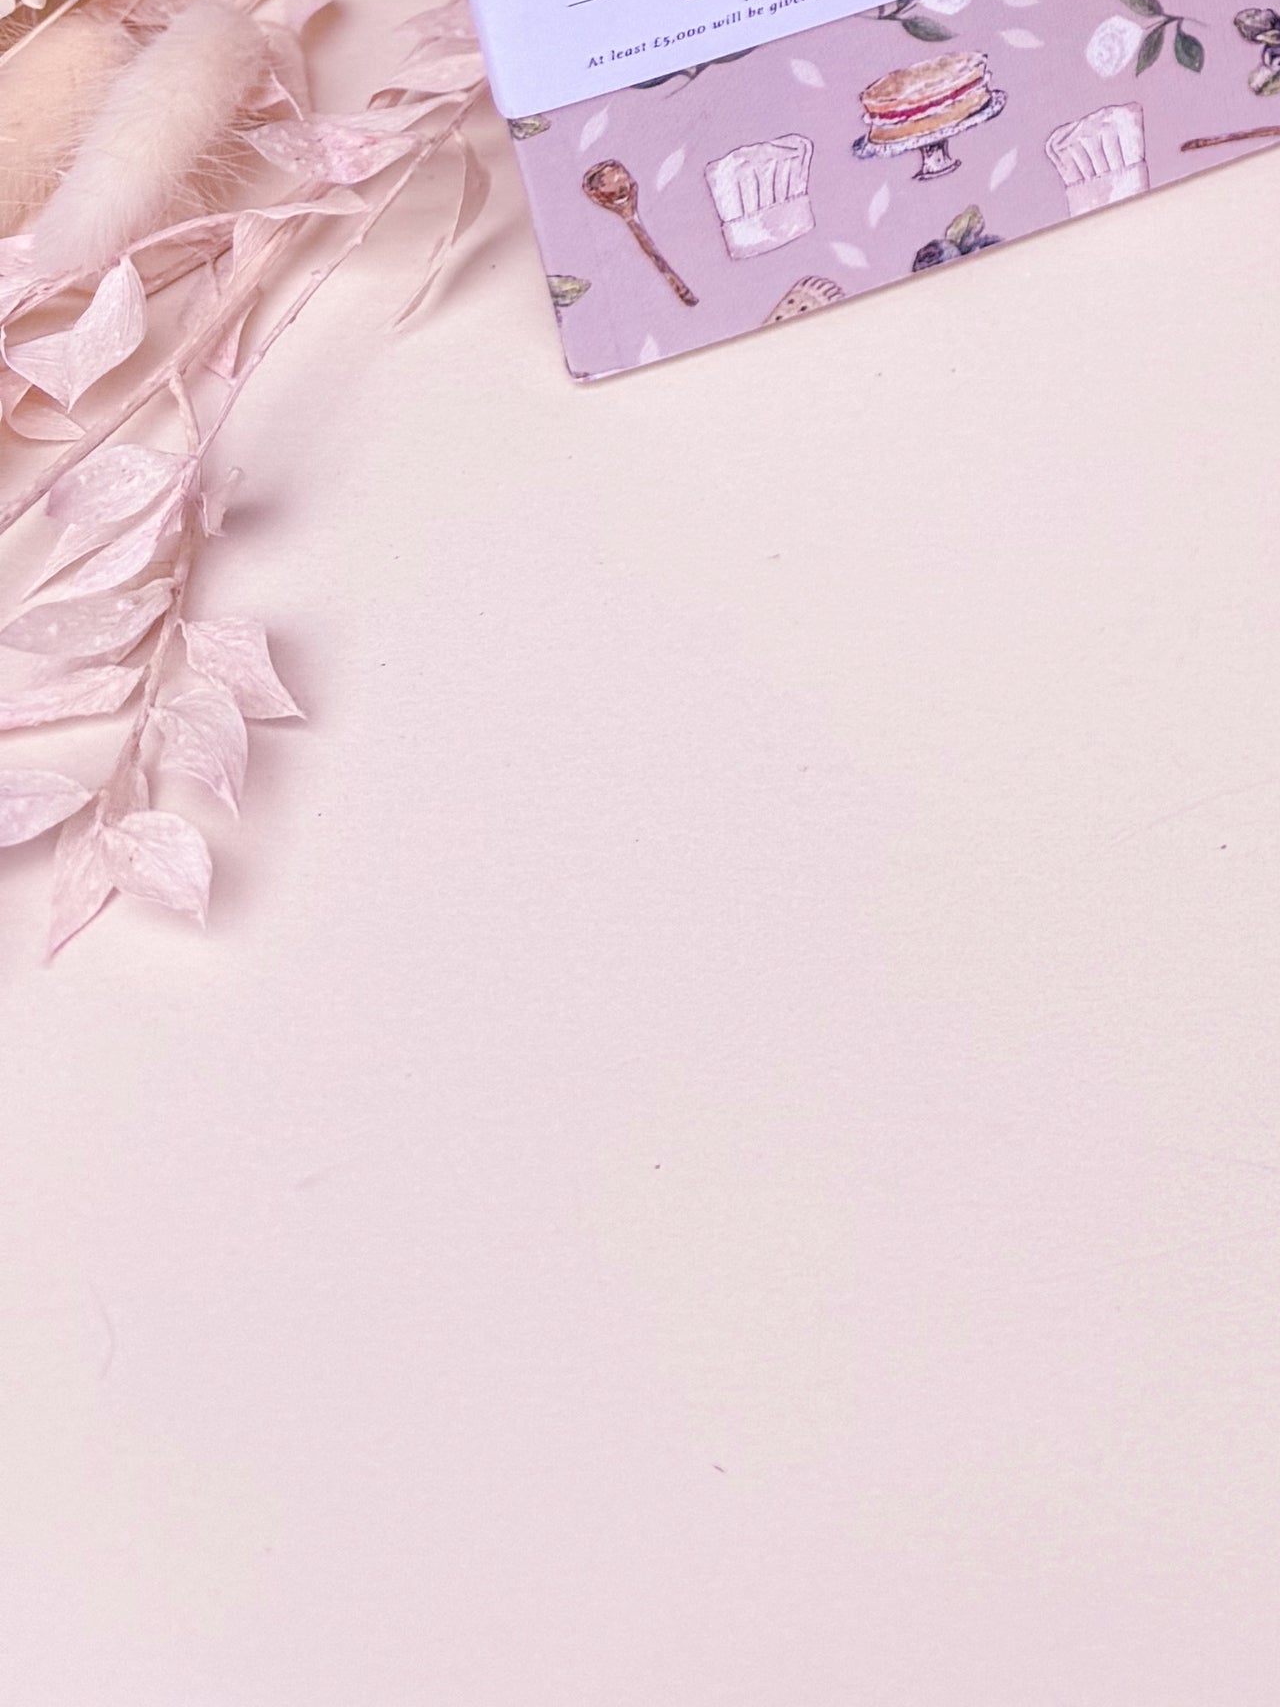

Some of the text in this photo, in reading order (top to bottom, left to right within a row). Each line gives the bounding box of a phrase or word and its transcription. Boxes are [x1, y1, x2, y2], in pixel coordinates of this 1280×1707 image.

[587, 53, 605, 69] At
[611, 42, 647, 61] least
[653, 25, 706, 49] £5,000
[712, 10, 742, 30] will
[748, 1, 765, 19] be
